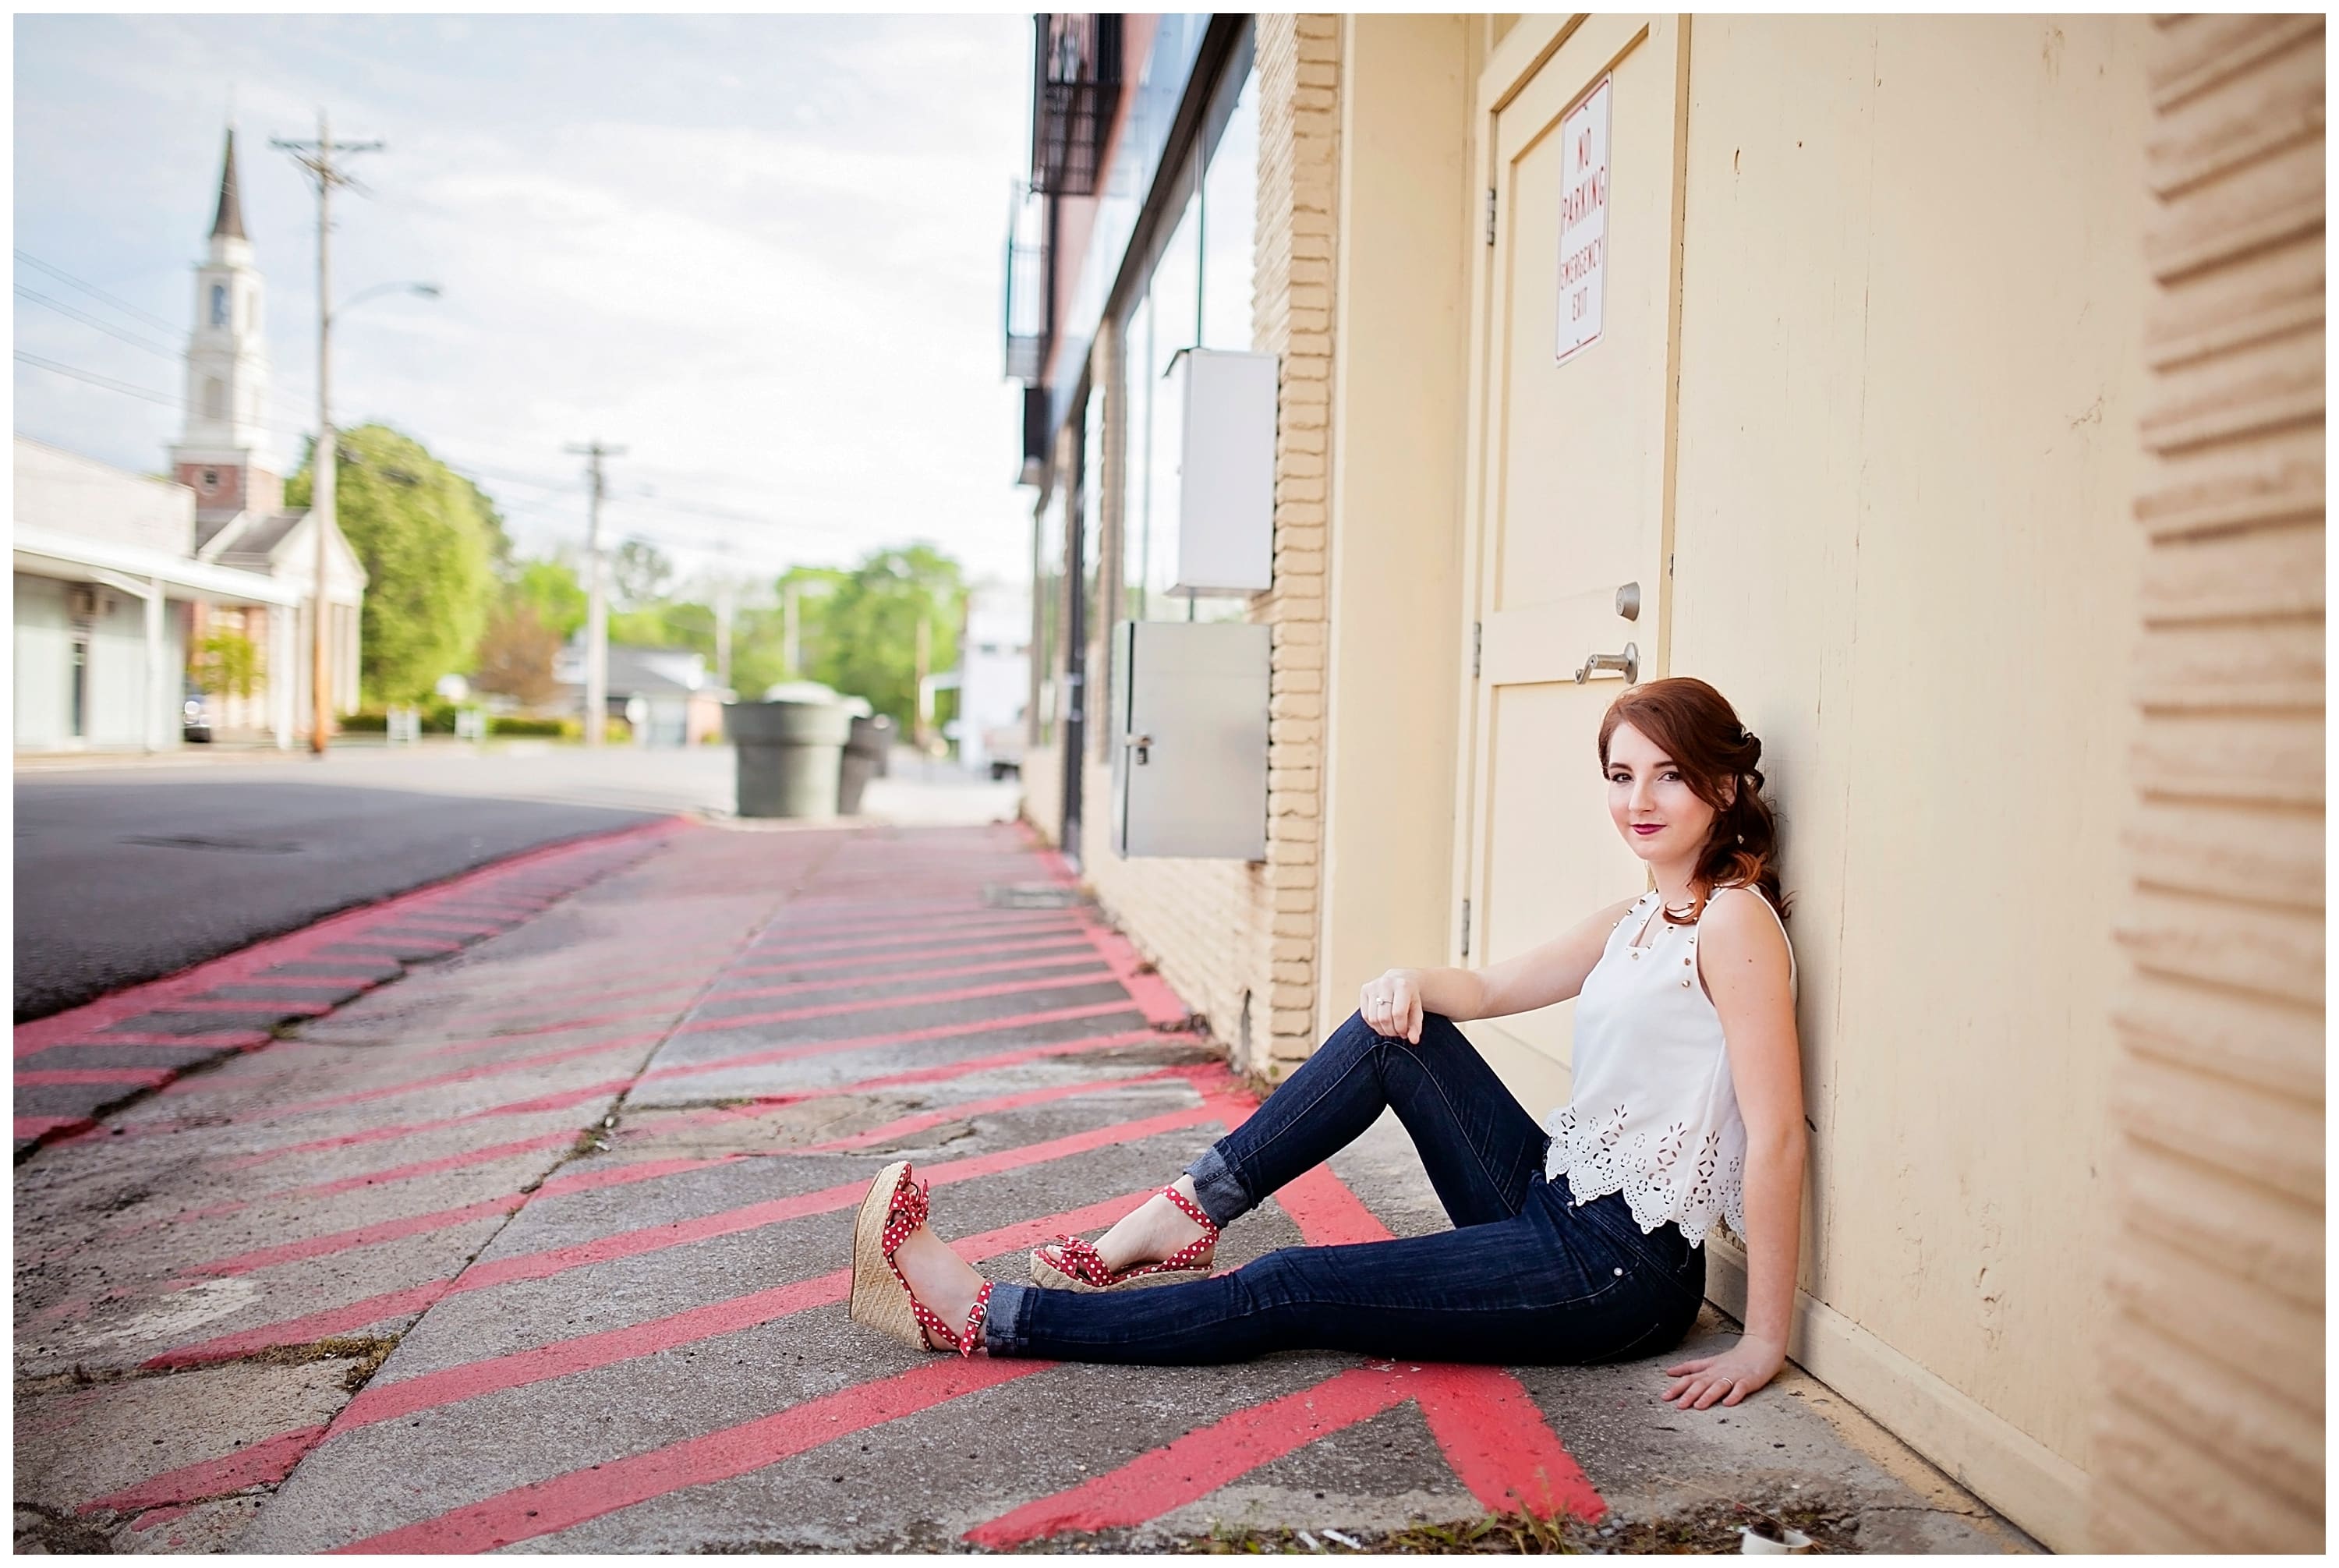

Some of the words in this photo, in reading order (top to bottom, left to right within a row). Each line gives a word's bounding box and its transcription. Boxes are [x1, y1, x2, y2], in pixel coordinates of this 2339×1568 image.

[1576, 127, 1591, 173] NO
[1562, 166, 1605, 231] PARKING
[1561, 236, 1602, 290] EMERGENCY
[1573, 286, 1588, 321] EXIT
